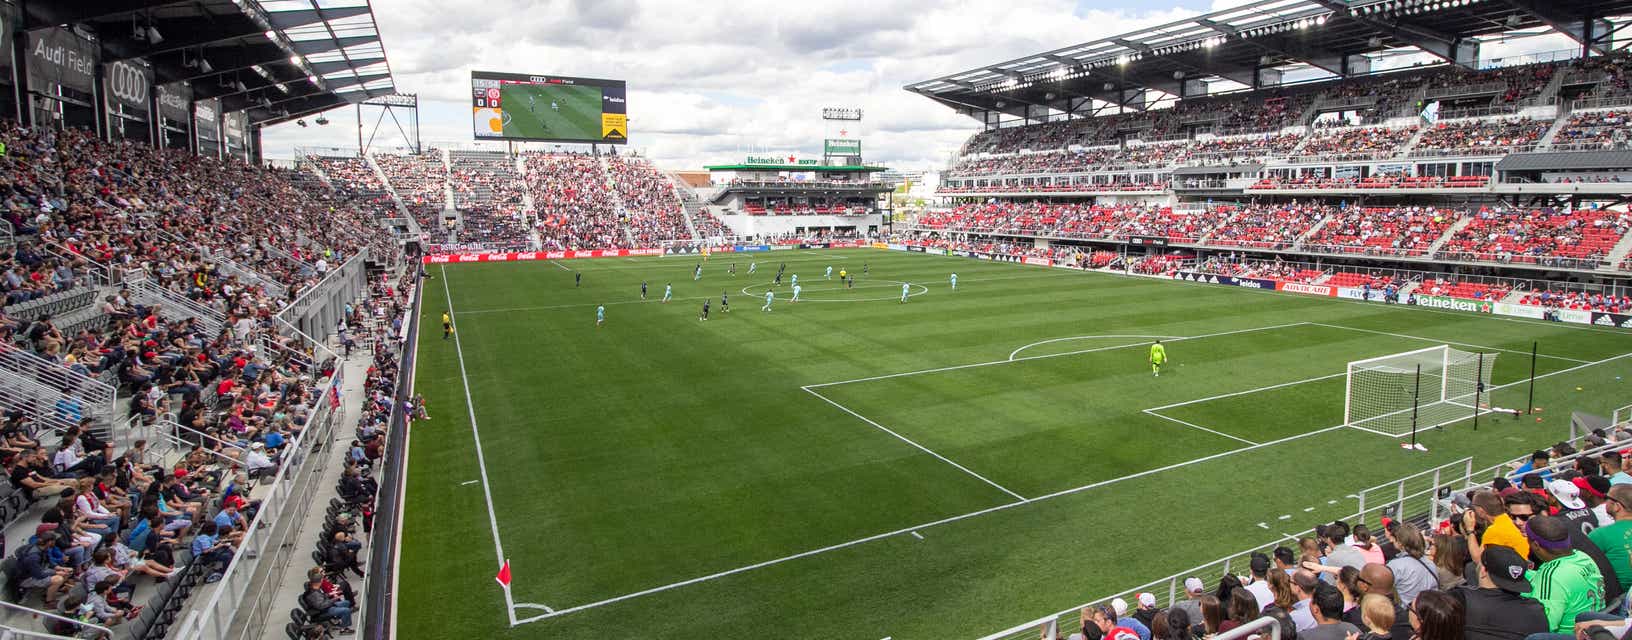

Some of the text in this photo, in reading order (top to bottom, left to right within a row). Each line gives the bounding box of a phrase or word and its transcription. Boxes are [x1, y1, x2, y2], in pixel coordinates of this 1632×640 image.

[34, 38, 93, 76] Audi Field
[478, 99, 498, 108] 0 0
[747, 156, 785, 165] Heineken
[1240, 279, 1261, 289] leidos
